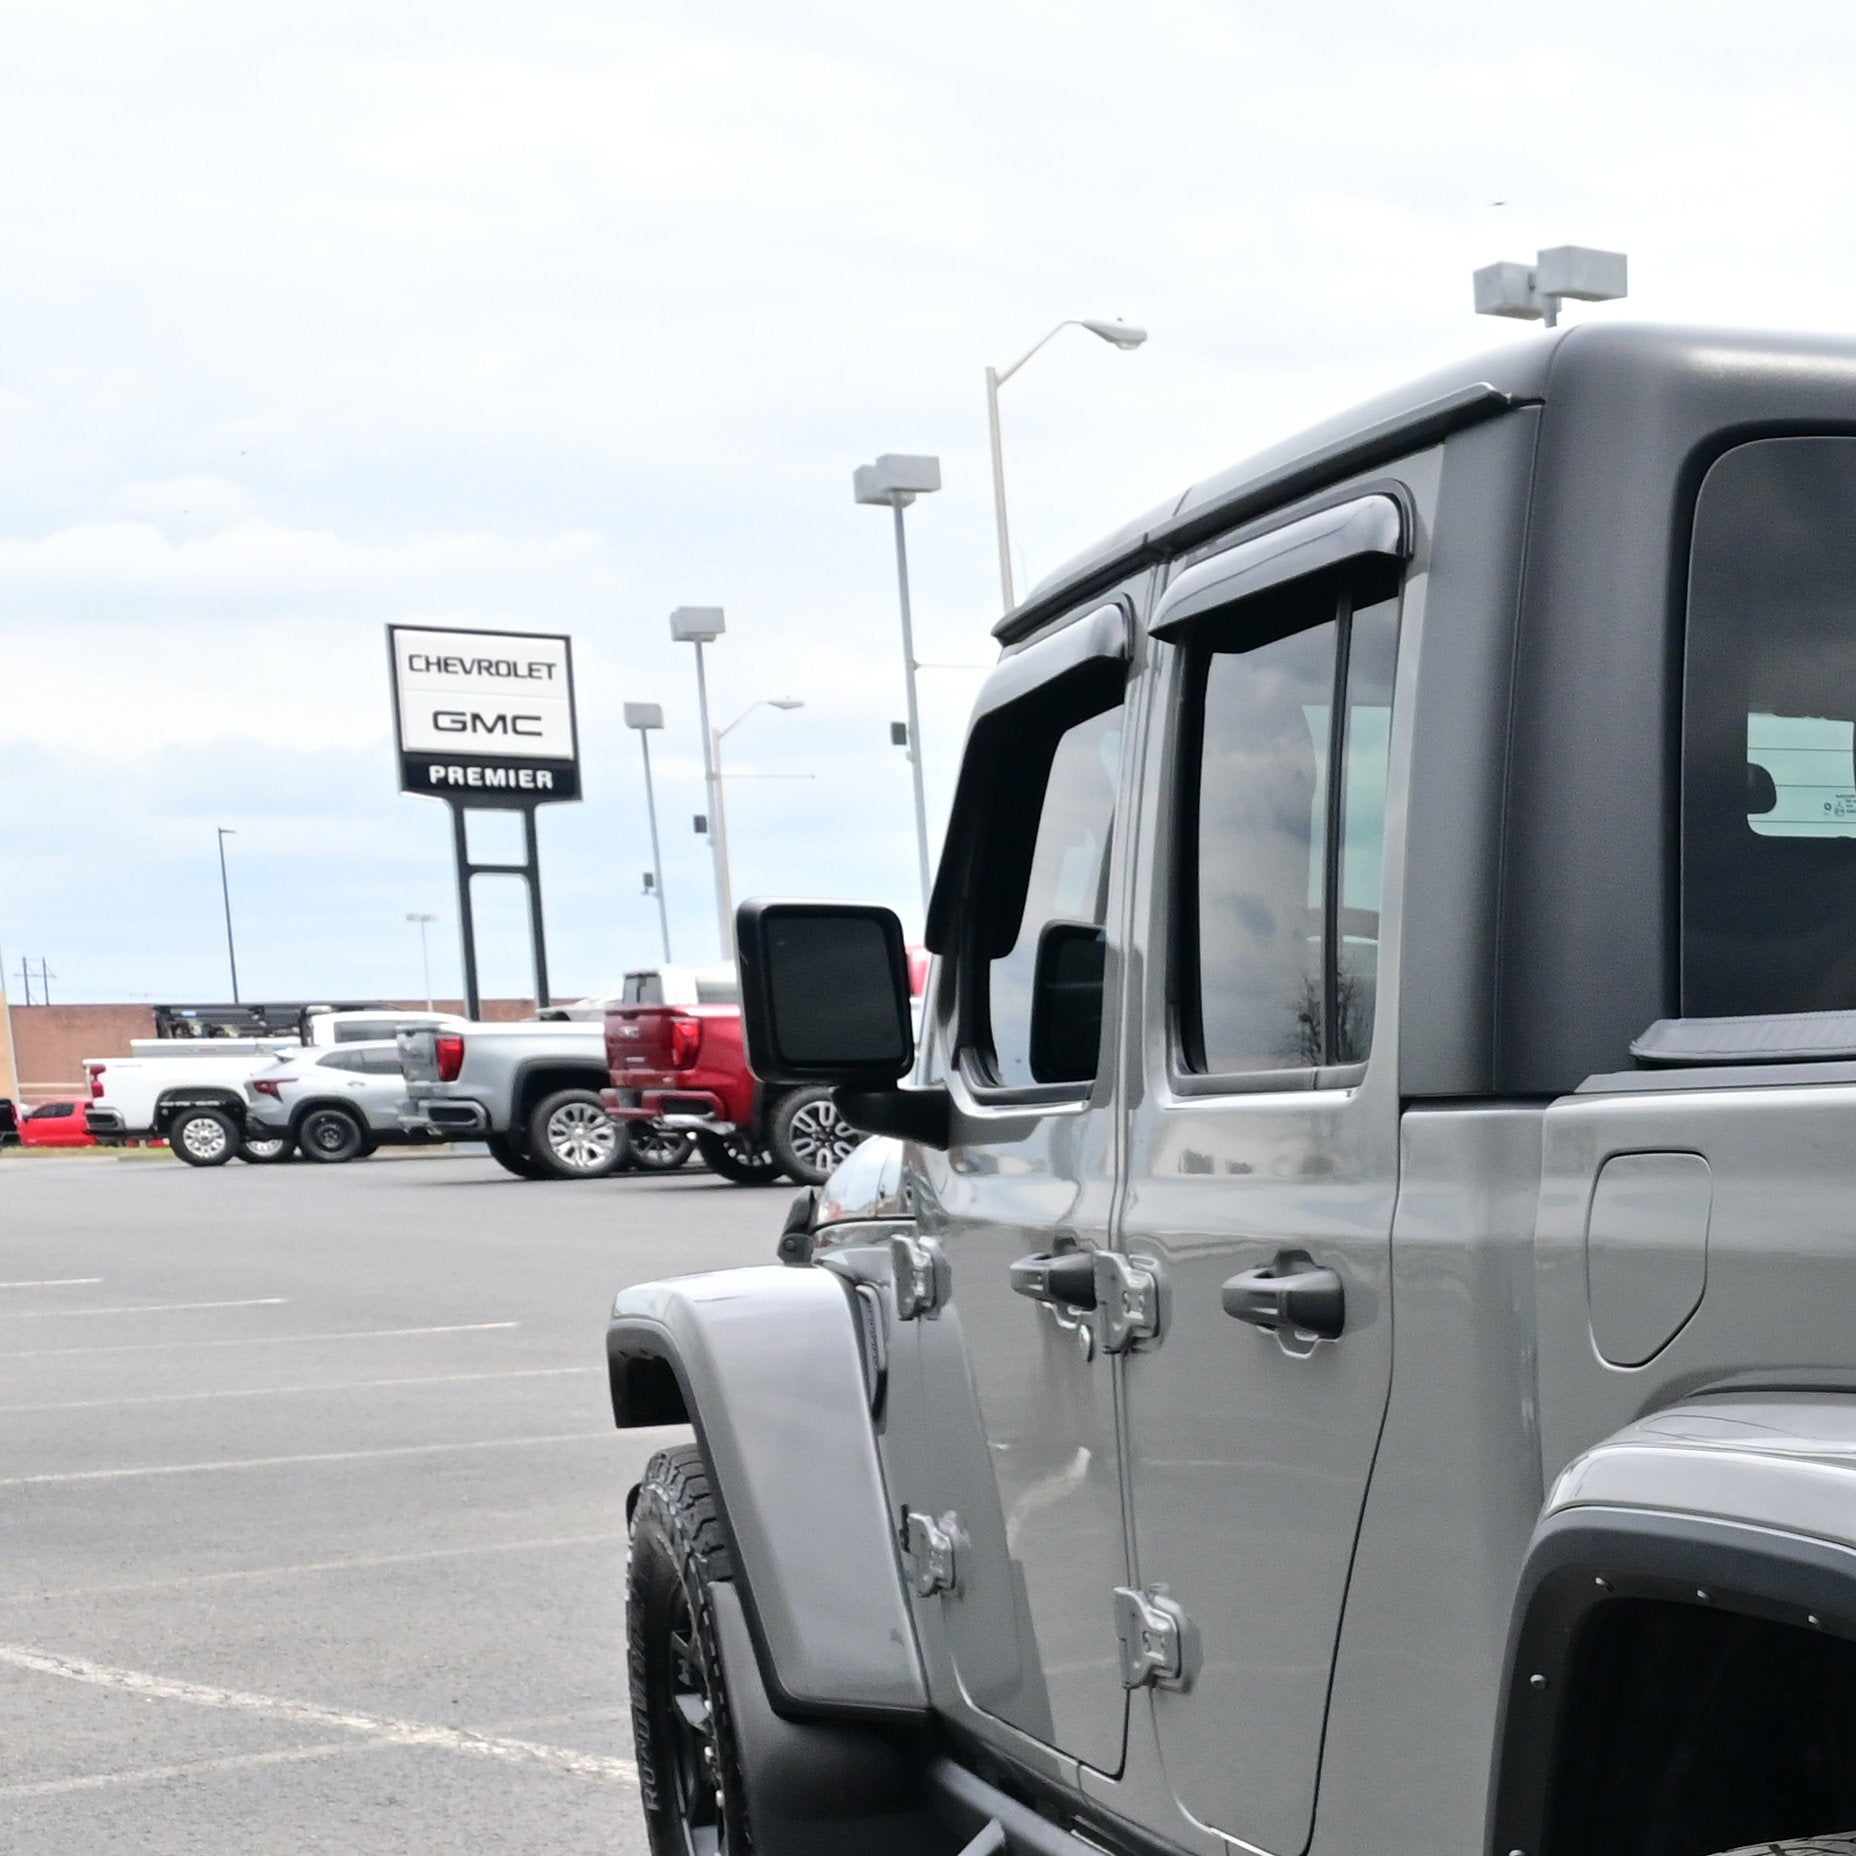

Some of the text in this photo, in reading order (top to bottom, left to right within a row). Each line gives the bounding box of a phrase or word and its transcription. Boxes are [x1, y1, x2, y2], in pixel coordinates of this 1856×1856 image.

[408, 654, 557, 680] CHEVROLET
[432, 710, 543, 737] GMC
[428, 765, 553, 789] PREMIER
